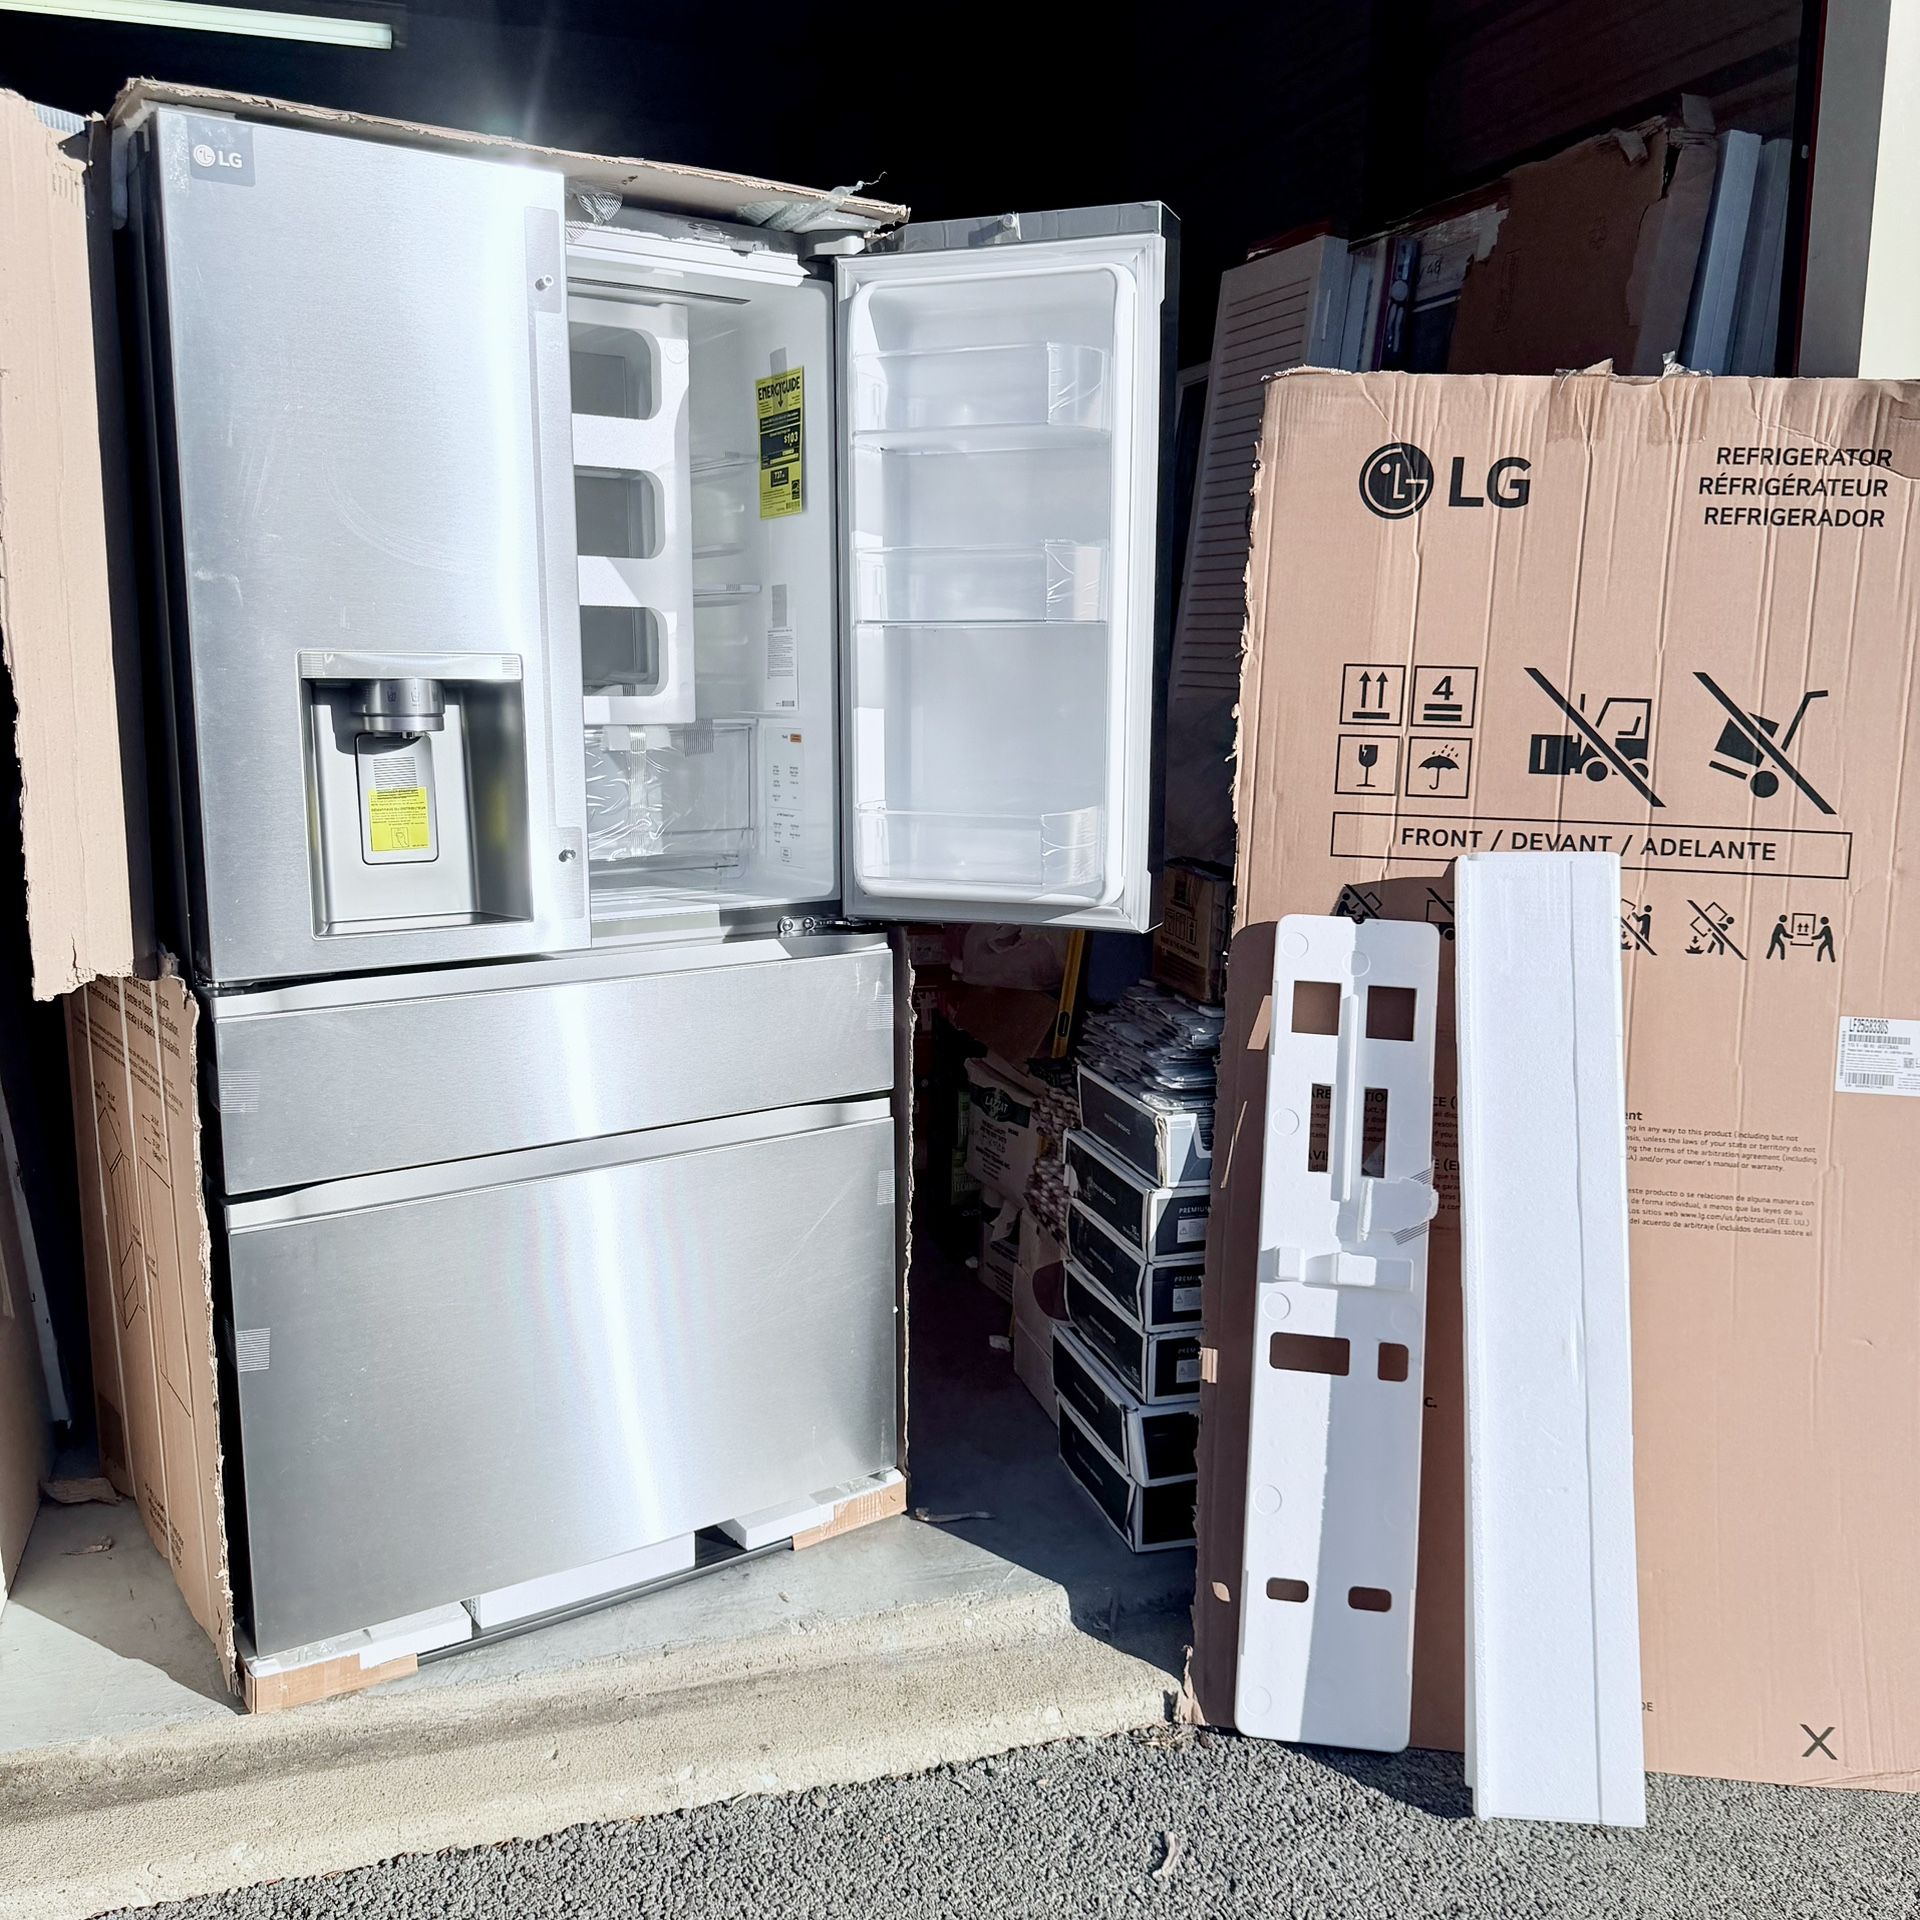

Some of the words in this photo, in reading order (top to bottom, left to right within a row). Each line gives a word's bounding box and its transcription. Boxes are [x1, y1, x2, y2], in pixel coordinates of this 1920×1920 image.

[218, 150, 243, 169] LG
[1716, 447, 1893, 467] REFRIGERATOR
[1448, 456, 1532, 509] LG
[1698, 472, 1889, 497] RÉFRIGÉRATEUR
[1704, 506, 1885, 527] REFRIGERADOR
[1401, 827, 1483, 848] FRONT
[1511, 831, 1612, 852] DEVANT
[1640, 836, 1776, 861] ADELANTE
[1647, 1125, 1660, 1134] any
[1662, 1127, 1676, 1135] way
[1678, 1127, 1686, 1135] to
[1688, 1128, 1702, 1136] this
[1704, 1129, 1732, 1138] product
[1771, 1133, 1784, 1141] but
[1653, 1146, 1675, 1154] terms
[1686, 1148, 1698, 1156] the
[1701, 1149, 1740, 1159] arbitration
[1741, 1153, 1780, 1162] agreement
[1668, 1136, 1680, 1144] the
[1682, 1137, 1698, 1146] laws
[1700, 1138, 1709, 1146] of
[1728, 1141, 1747, 1149] state
[1759, 1143, 1790, 1153] territory
[1639, 1154, 1663, 1163] and/or
[1665, 1157, 1682, 1165] your
[1683, 1158, 1711, 1166] owner's
[1713, 1160, 1740, 1169] manual
[1628, 1187, 1643, 1195] este
[1645, 1188, 1678, 1198] producto
[1697, 1191, 1734, 1201] relacionen
[1736, 1194, 1745, 1202] de
[1747, 1195, 1771, 1204] alguna
[1772, 1197, 1799, 1206] manera
[1631, 1197, 1640, 1205] de
[1641, 1197, 1663, 1206] forma
[1709, 1203, 1733, 1211] menos
[1735, 1205, 1749, 1213] que
[1750, 1205, 1761, 1213] las
[1763, 1206, 1782, 1215] leyes
[1784, 1208, 1793, 1216] de
[1643, 1208, 1662, 1217] sitios
[1664, 1210, 1679, 1218] web
[1642, 1218, 1671, 1228] acuerdo
[1673, 1220, 1682, 1228] de
[1684, 1220, 1715, 1232] arbitraje
[1753, 1226, 1781, 1236] detalles
[1784, 1227, 1805, 1237] sobre
